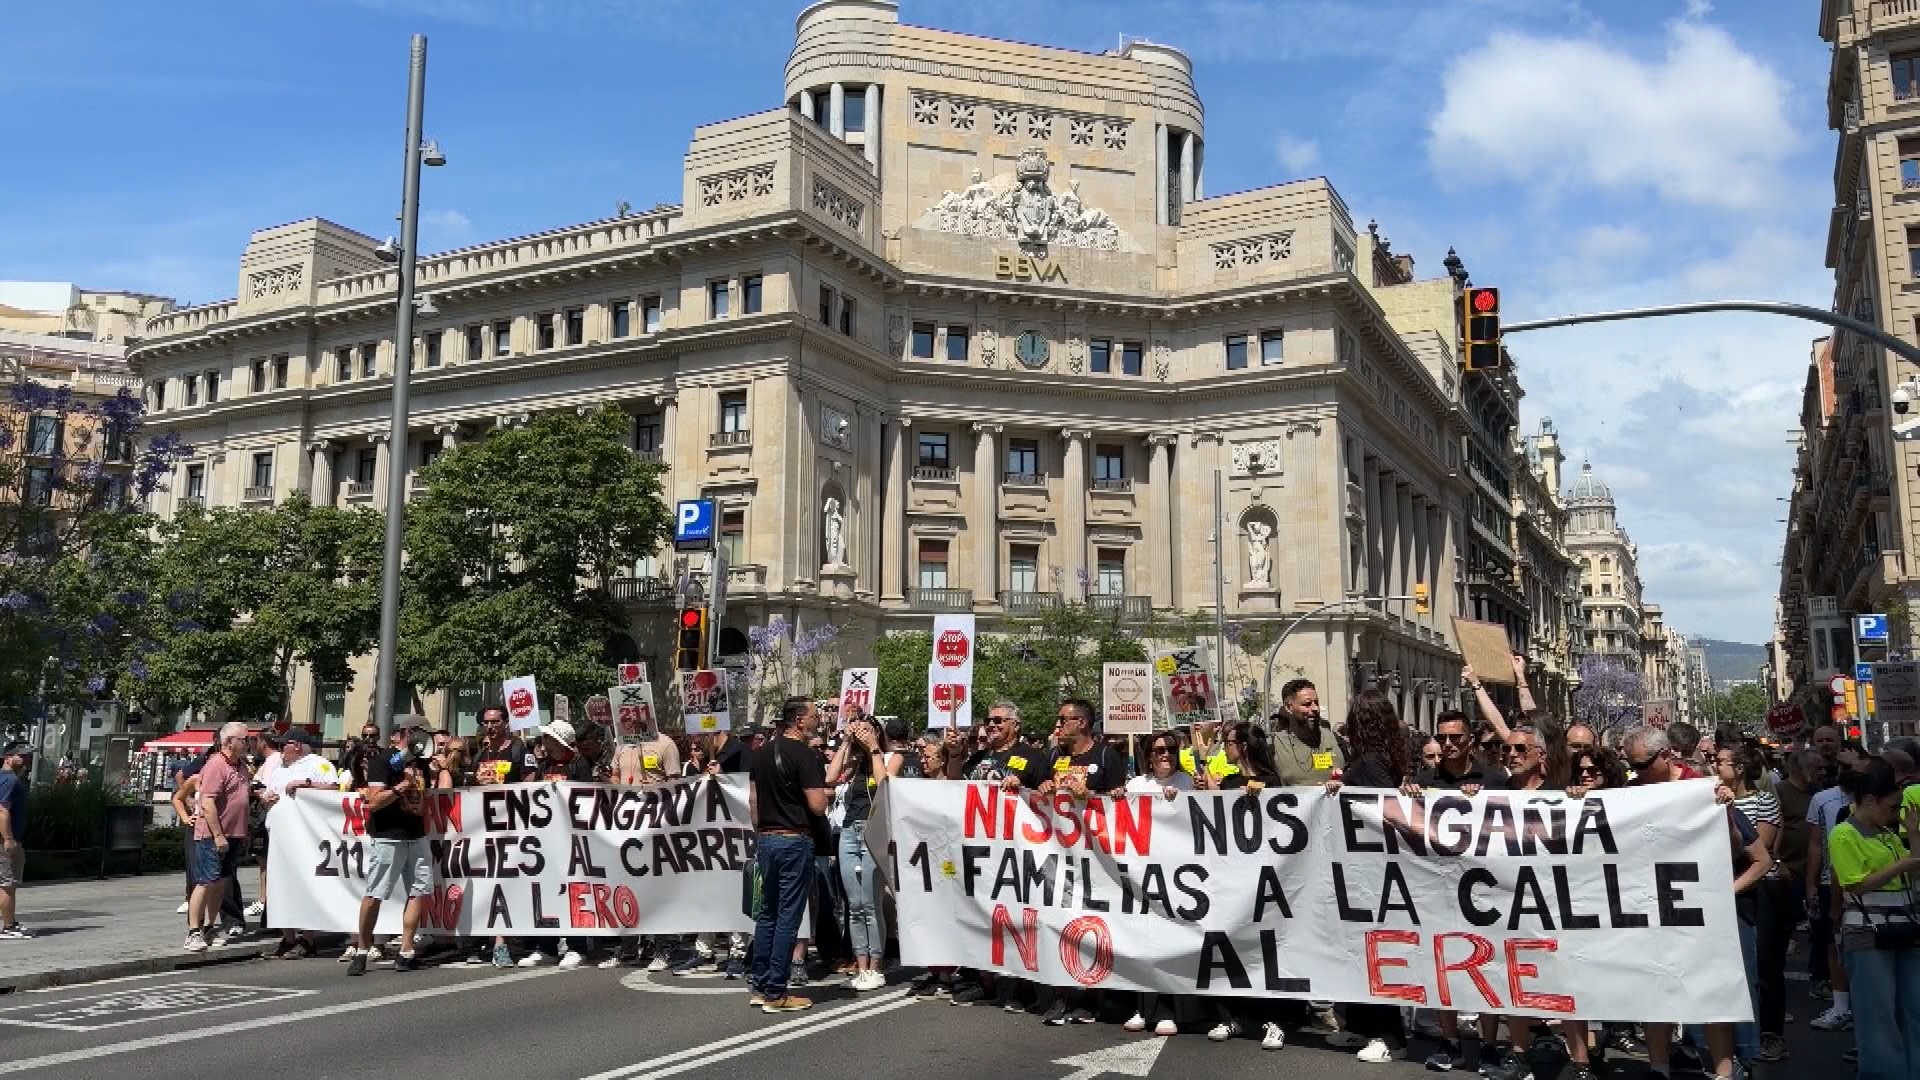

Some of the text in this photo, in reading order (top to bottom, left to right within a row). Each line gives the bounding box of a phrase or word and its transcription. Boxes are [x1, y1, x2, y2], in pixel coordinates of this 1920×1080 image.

[994, 254, 1068, 283] BBVA
[678, 503, 700, 535] P
[943, 633, 962, 642] STOP
[1859, 617, 1877, 636] P
[1109, 668, 1119, 676] NO
[1135, 668, 1146, 676] ERE
[1170, 673, 1209, 697] 211
[844, 689, 869, 704] 211
[1121, 704, 1145, 712] CIERRE
[619, 704, 650, 722] 211
[483, 788, 552, 832] ENS
[568, 779, 732, 831] ENGANYA
[1188, 793, 1309, 857] NOS
[1339, 793, 1619, 857] ENGAÑA
[316, 840, 364, 878] 211
[568, 835, 606, 878] AL
[420, 882, 640, 930] NO A L'ERO
[1253, 865, 1294, 922] A
[1331, 861, 1421, 925] LA
[1457, 861, 1705, 931] CALLE
[991, 903, 1576, 1014] NO AL ERE
